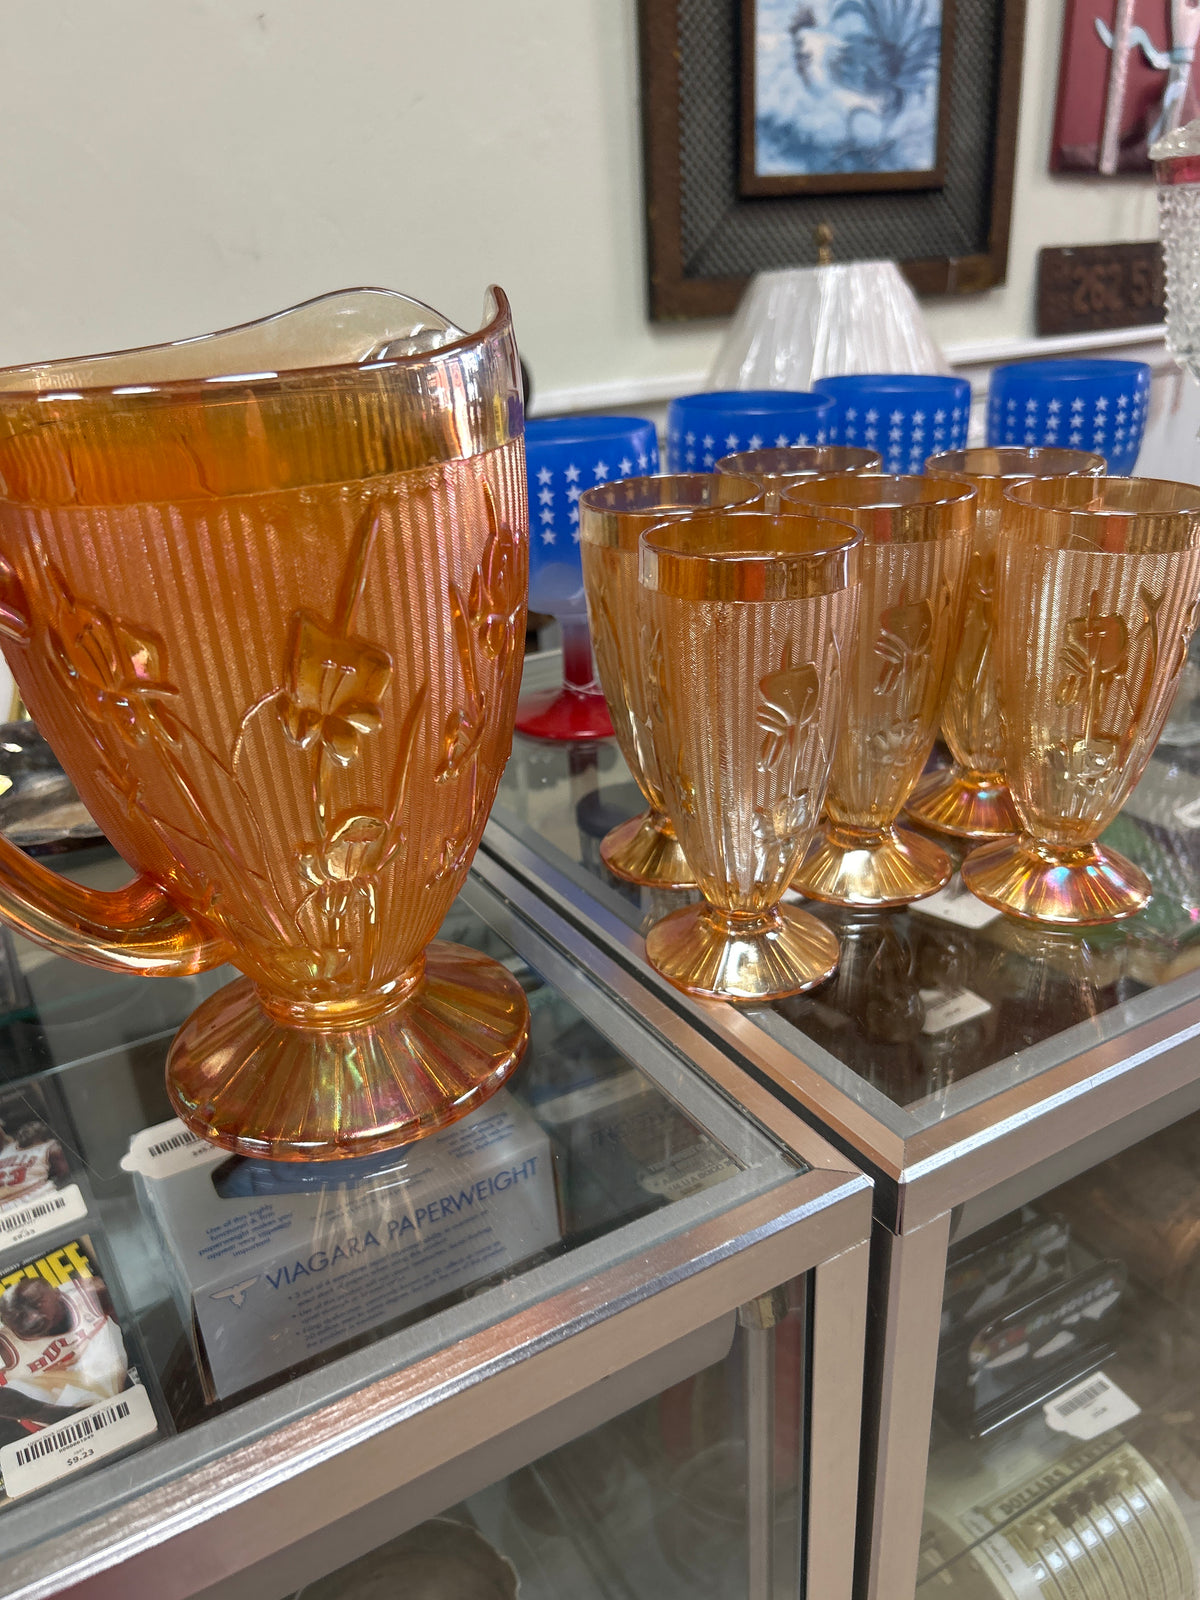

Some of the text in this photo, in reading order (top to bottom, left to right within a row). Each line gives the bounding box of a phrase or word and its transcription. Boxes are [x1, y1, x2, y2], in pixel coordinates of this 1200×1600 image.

[266, 1228, 379, 1290] VIAGARA
[387, 1156, 540, 1240] PAPERWEIGHT
[66, 1448, 94, 1466] $9.23
